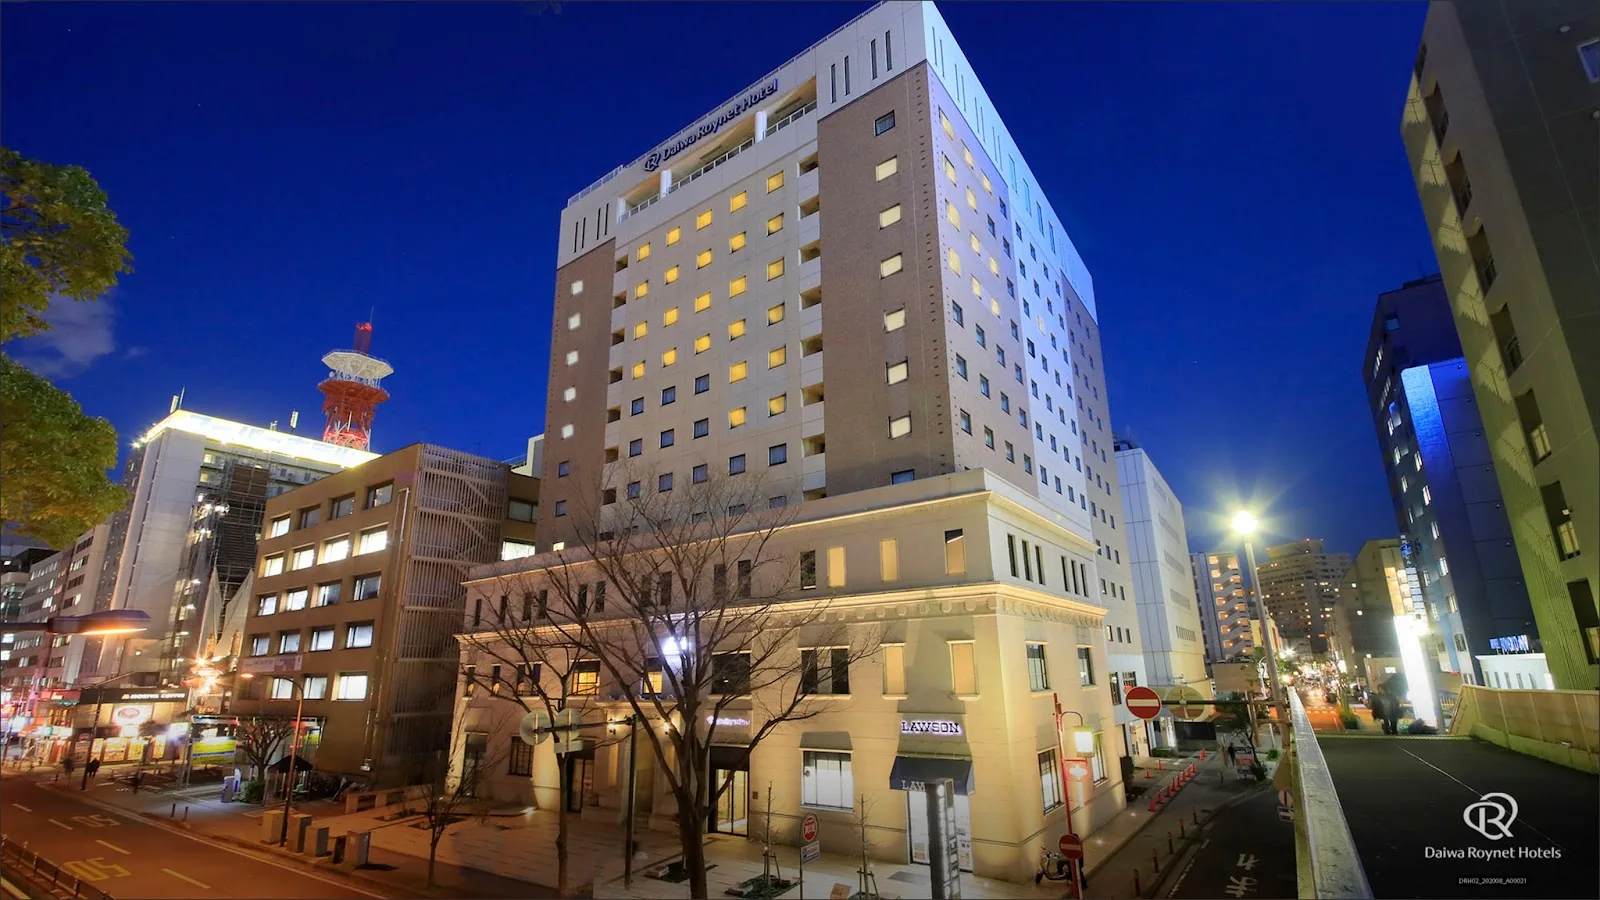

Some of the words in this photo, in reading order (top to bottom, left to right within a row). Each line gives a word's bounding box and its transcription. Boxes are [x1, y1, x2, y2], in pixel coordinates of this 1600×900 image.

[663, 136, 696, 161] Daiwa
[695, 103, 741, 139] Roynet
[741, 79, 778, 112] Hotel
[901, 721, 960, 733] LAWSON
[901, 780, 926, 792] LAW
